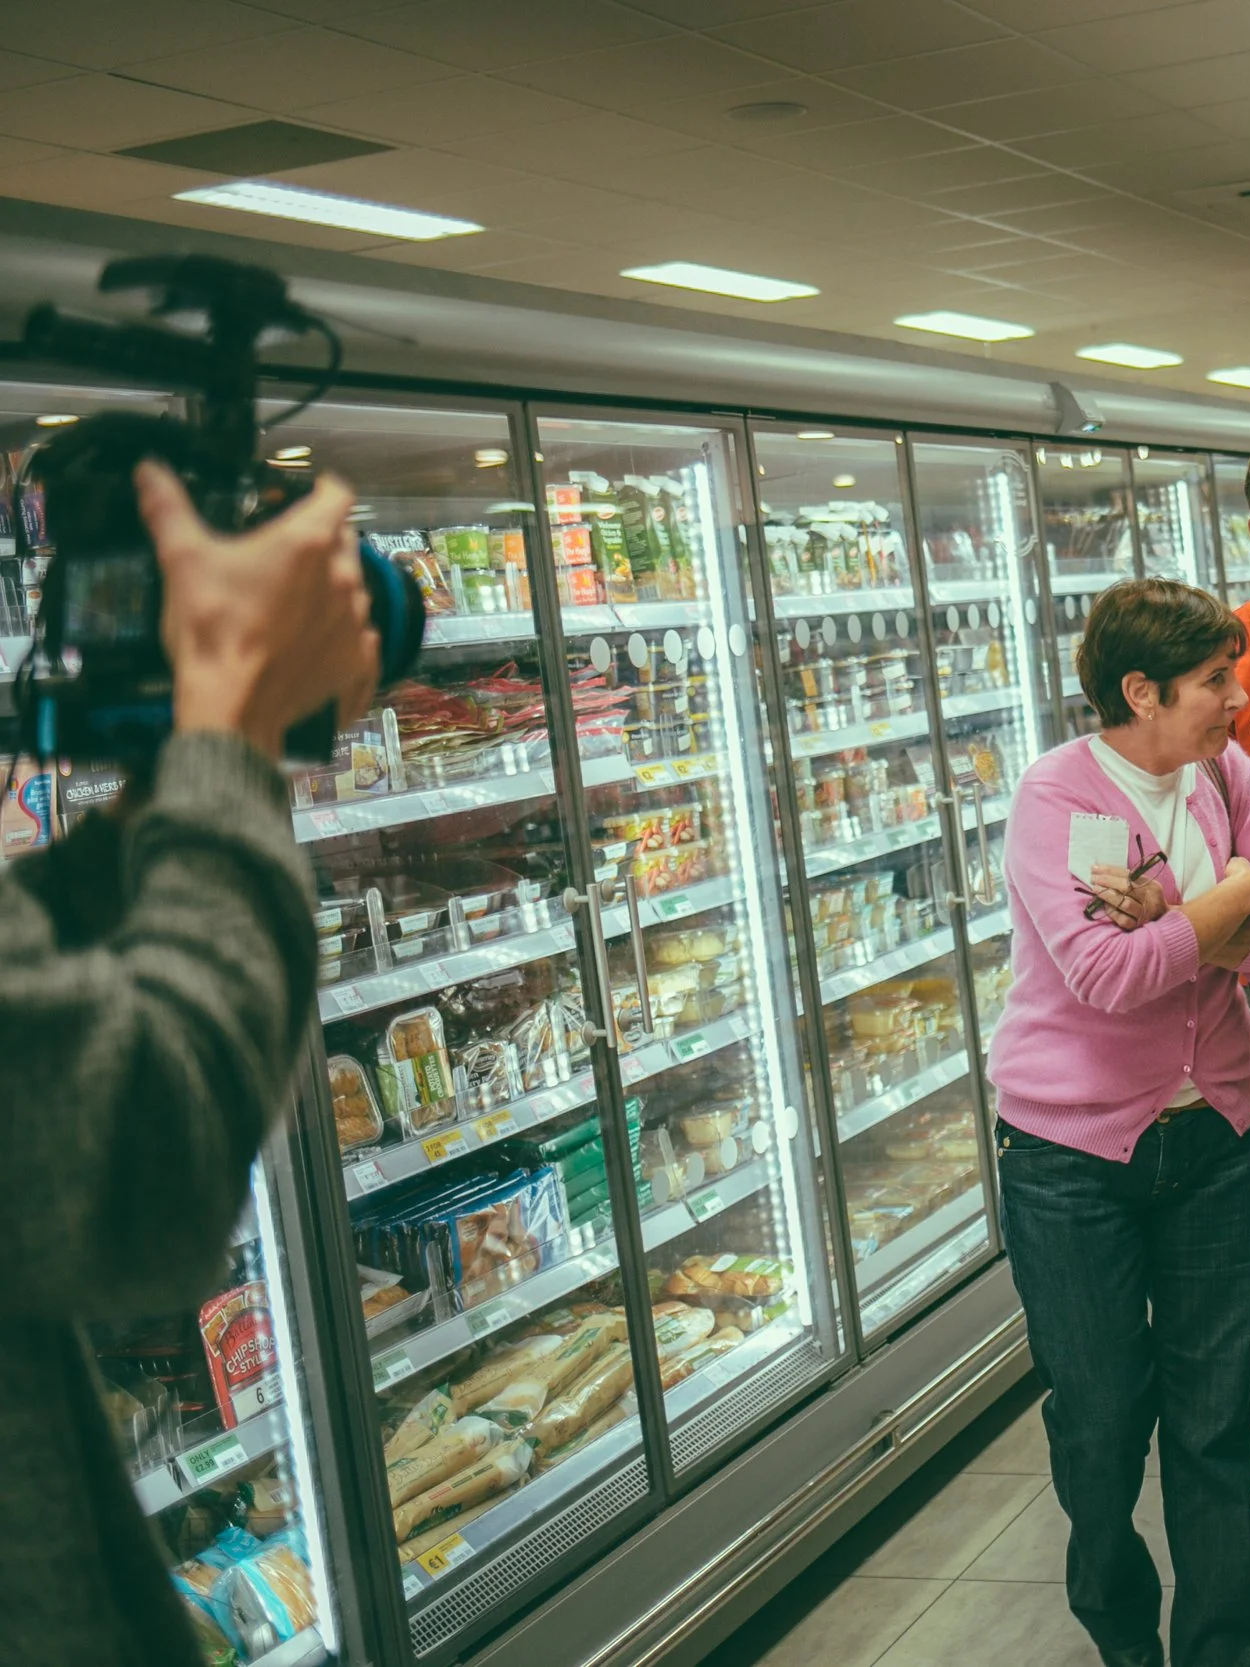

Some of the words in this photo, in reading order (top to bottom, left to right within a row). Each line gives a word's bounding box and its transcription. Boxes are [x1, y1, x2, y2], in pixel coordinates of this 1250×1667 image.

[66, 786, 94, 800] CHICKEN
[425, 1065, 437, 1092] POTATO
[226, 1337, 276, 1374] CHIPSHOP
[256, 1387, 265, 1404] 6
[189, 1449, 210, 1465] ONLY
[195, 1458, 215, 1473] €2.99
[427, 1554, 446, 1571] €1
